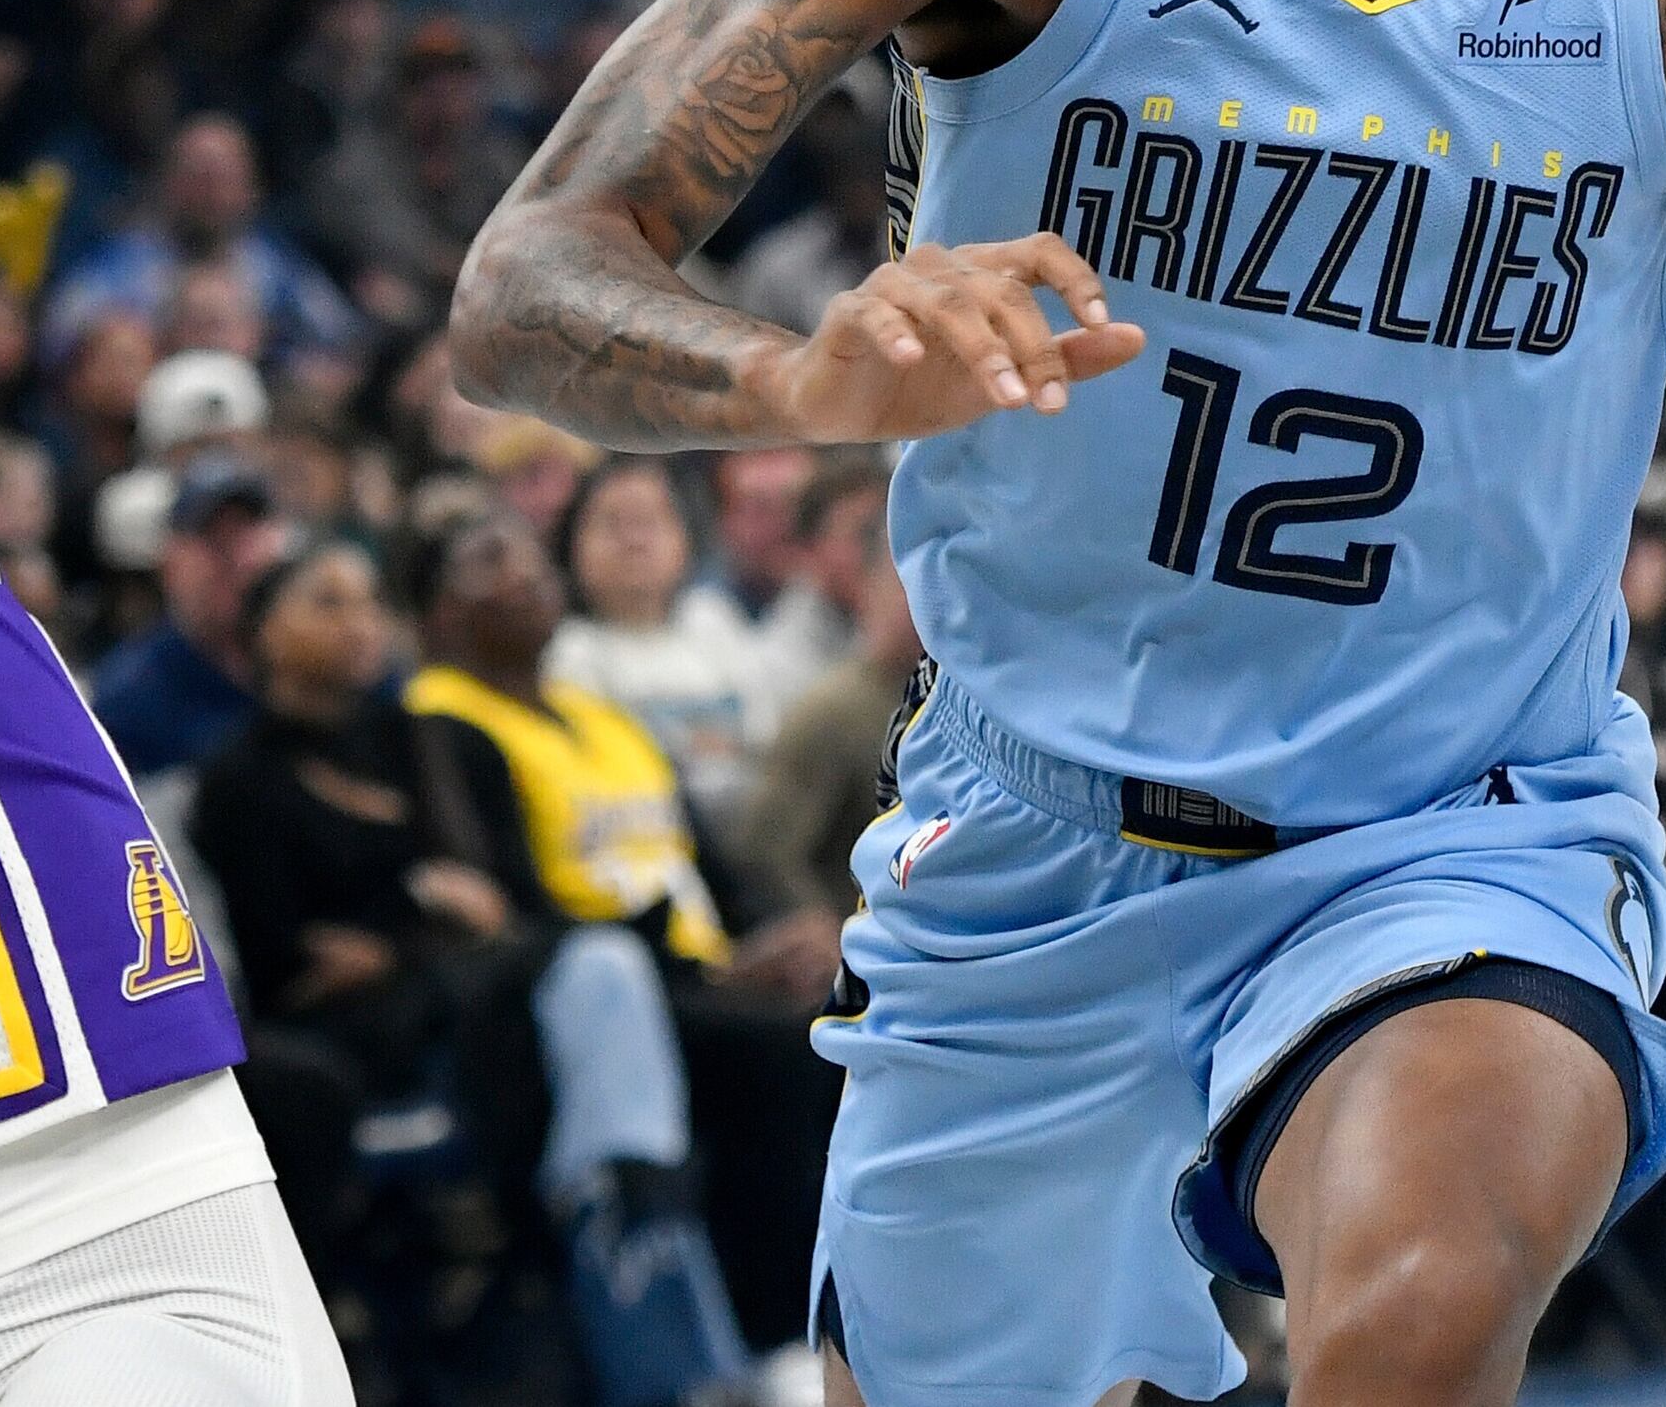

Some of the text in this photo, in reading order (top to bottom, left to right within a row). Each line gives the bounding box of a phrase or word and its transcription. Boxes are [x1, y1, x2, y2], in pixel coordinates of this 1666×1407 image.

[1457, 32, 1602, 59] Robinhood
[1141, 95, 1562, 178] MEMPHIS
[1037, 97, 1625, 357] GRIZZLIES
[1148, 347, 1425, 606] 12
